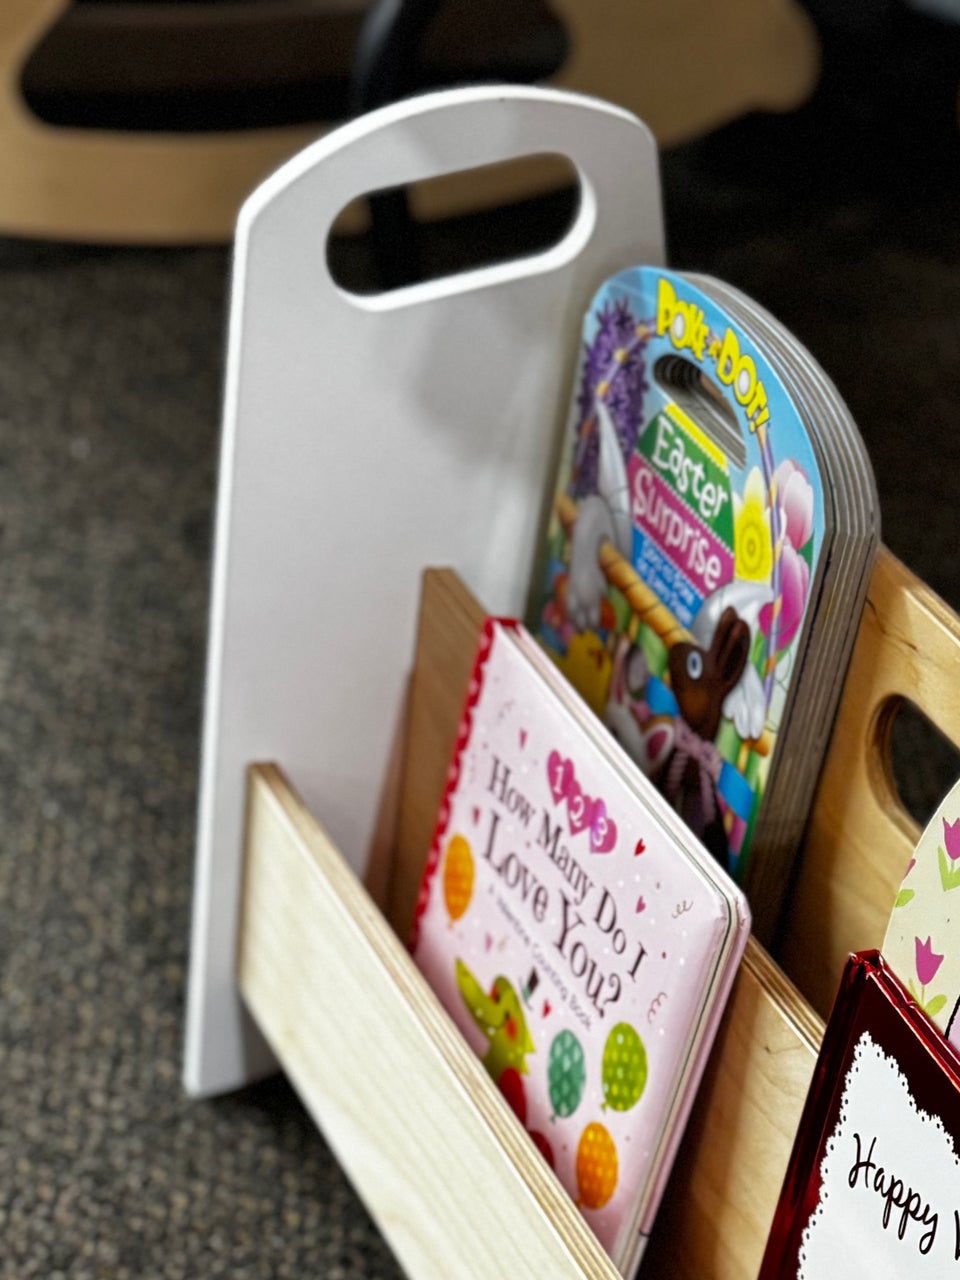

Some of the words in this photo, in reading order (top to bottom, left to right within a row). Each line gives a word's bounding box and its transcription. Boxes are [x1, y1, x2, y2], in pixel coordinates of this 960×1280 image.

[651, 414, 728, 518] Easter
[633, 467, 722, 590] Surprise
[481, 809, 548, 922] Love
[552, 888, 623, 1019] You?
[486, 755, 536, 828] How
[536, 807, 595, 906] Many
[593, 886, 627, 955] Do
[626, 943, 650, 983] I
[848, 1133, 939, 1254] Happy
